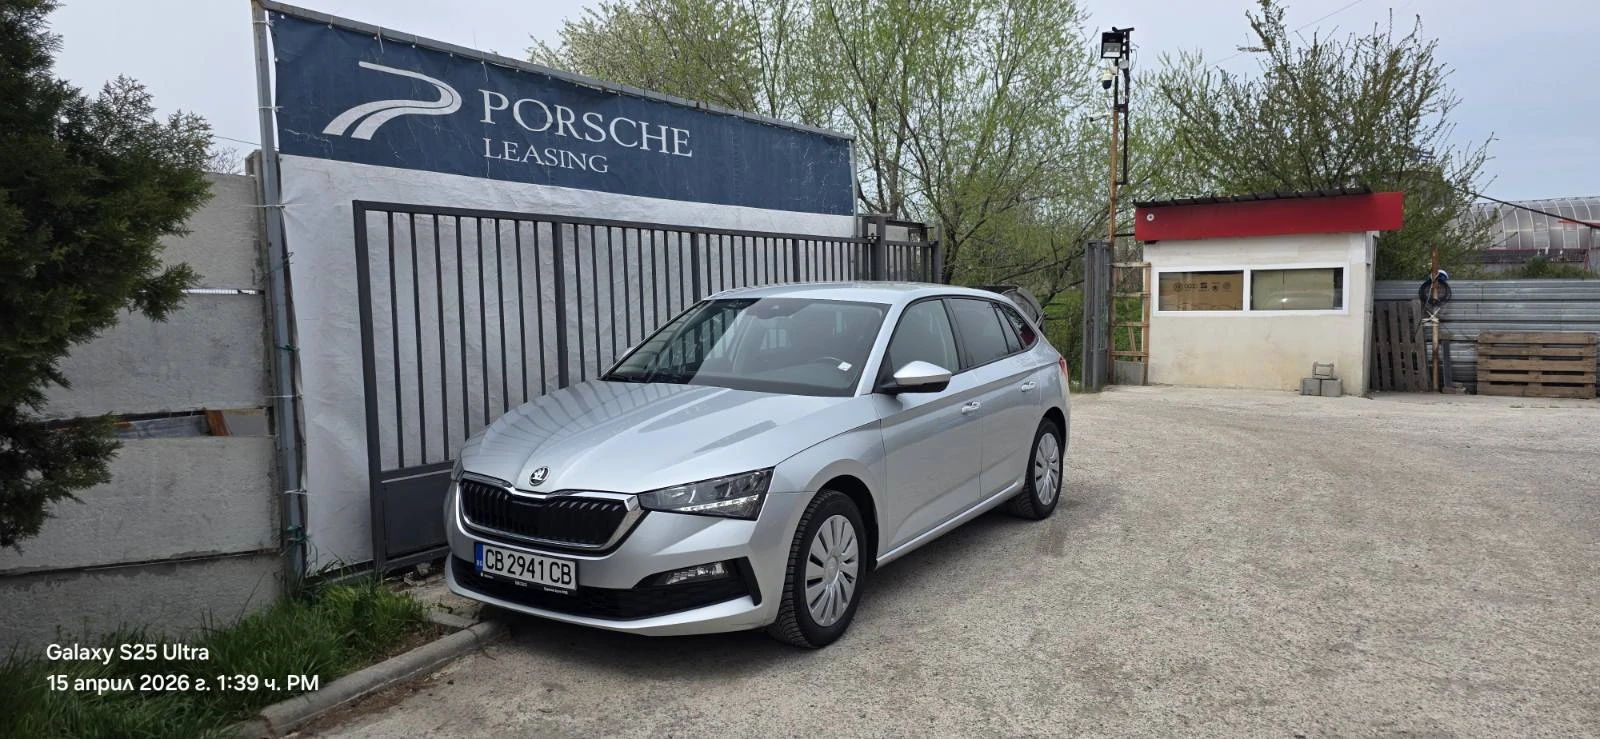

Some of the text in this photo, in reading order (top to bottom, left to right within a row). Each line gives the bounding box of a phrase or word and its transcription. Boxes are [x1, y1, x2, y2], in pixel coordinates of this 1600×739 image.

[477, 88, 693, 158] PORSCHE
[482, 137, 609, 174] LEASING
[485, 549, 572, 586] CB 2941 CB
